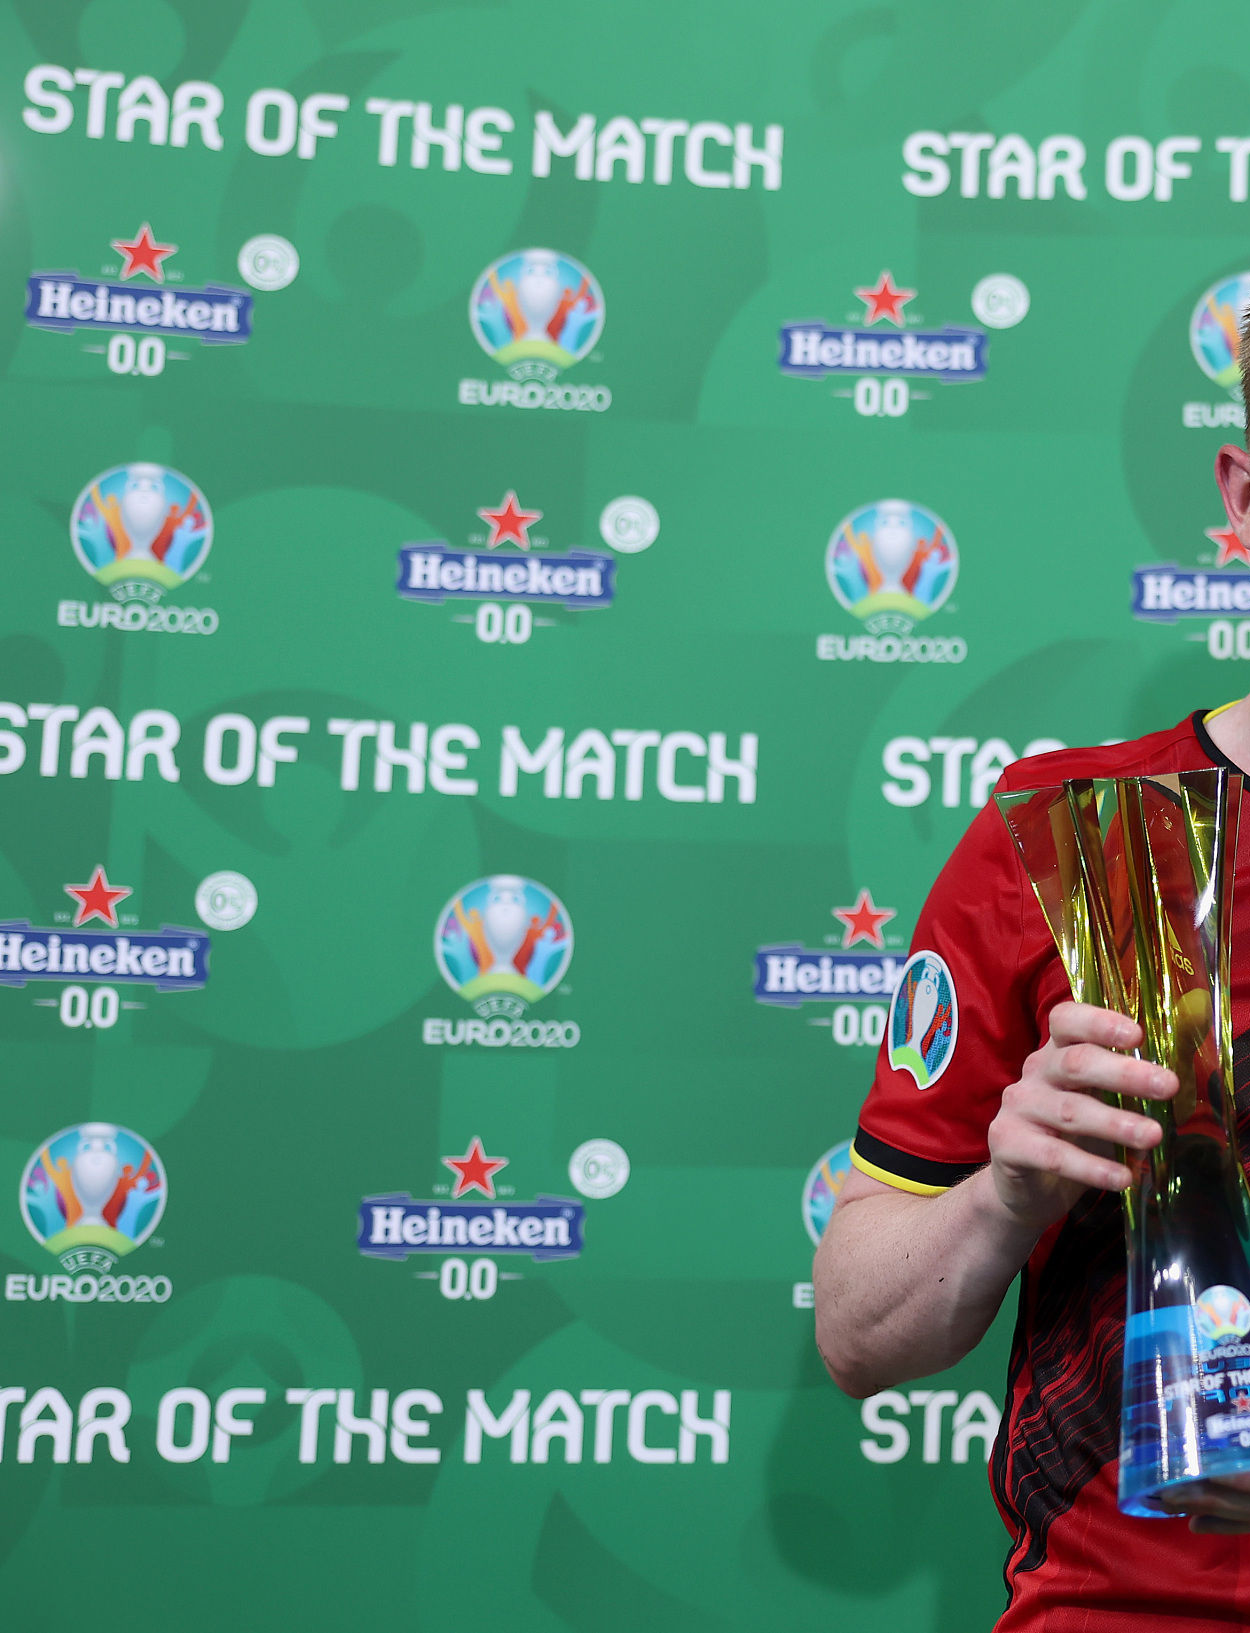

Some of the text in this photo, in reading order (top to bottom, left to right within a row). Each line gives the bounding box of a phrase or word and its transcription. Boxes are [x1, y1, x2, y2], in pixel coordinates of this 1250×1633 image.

[21, 63, 785, 192] STAR OF THE MATCH
[901, 130, 1088, 201] STAR
[1104, 135, 1203, 203] OF
[38, 279, 239, 335] Heineken
[106, 333, 167, 378] 0.0
[790, 330, 975, 370] Heineken
[458, 379, 612, 412] EURO2020
[853, 376, 911, 418] 0.0
[409, 552, 602, 597] Heineken
[57, 600, 219, 635] EURO2020
[474, 601, 534, 645] 0.0
[202, 712, 311, 788] OF
[326, 717, 481, 797] THE
[498, 724, 759, 805] MATCH
[881, 736, 1068, 808] STA
[0, 933, 195, 977] Heineken
[766, 955, 902, 995] Heinek
[58, 984, 120, 1030] 0.0
[832, 1004, 888, 1047] 0.0
[422, 1017, 581, 1048] EURO2020
[370, 1206, 570, 1247] Heineken
[62, 1252, 113, 1272] UEFA
[439, 1257, 499, 1301] 0.0
[5, 1274, 172, 1303] EURO2020
[0, 1386, 732, 1465] TAR OF THE MATCH
[859, 1389, 1003, 1464] STA
